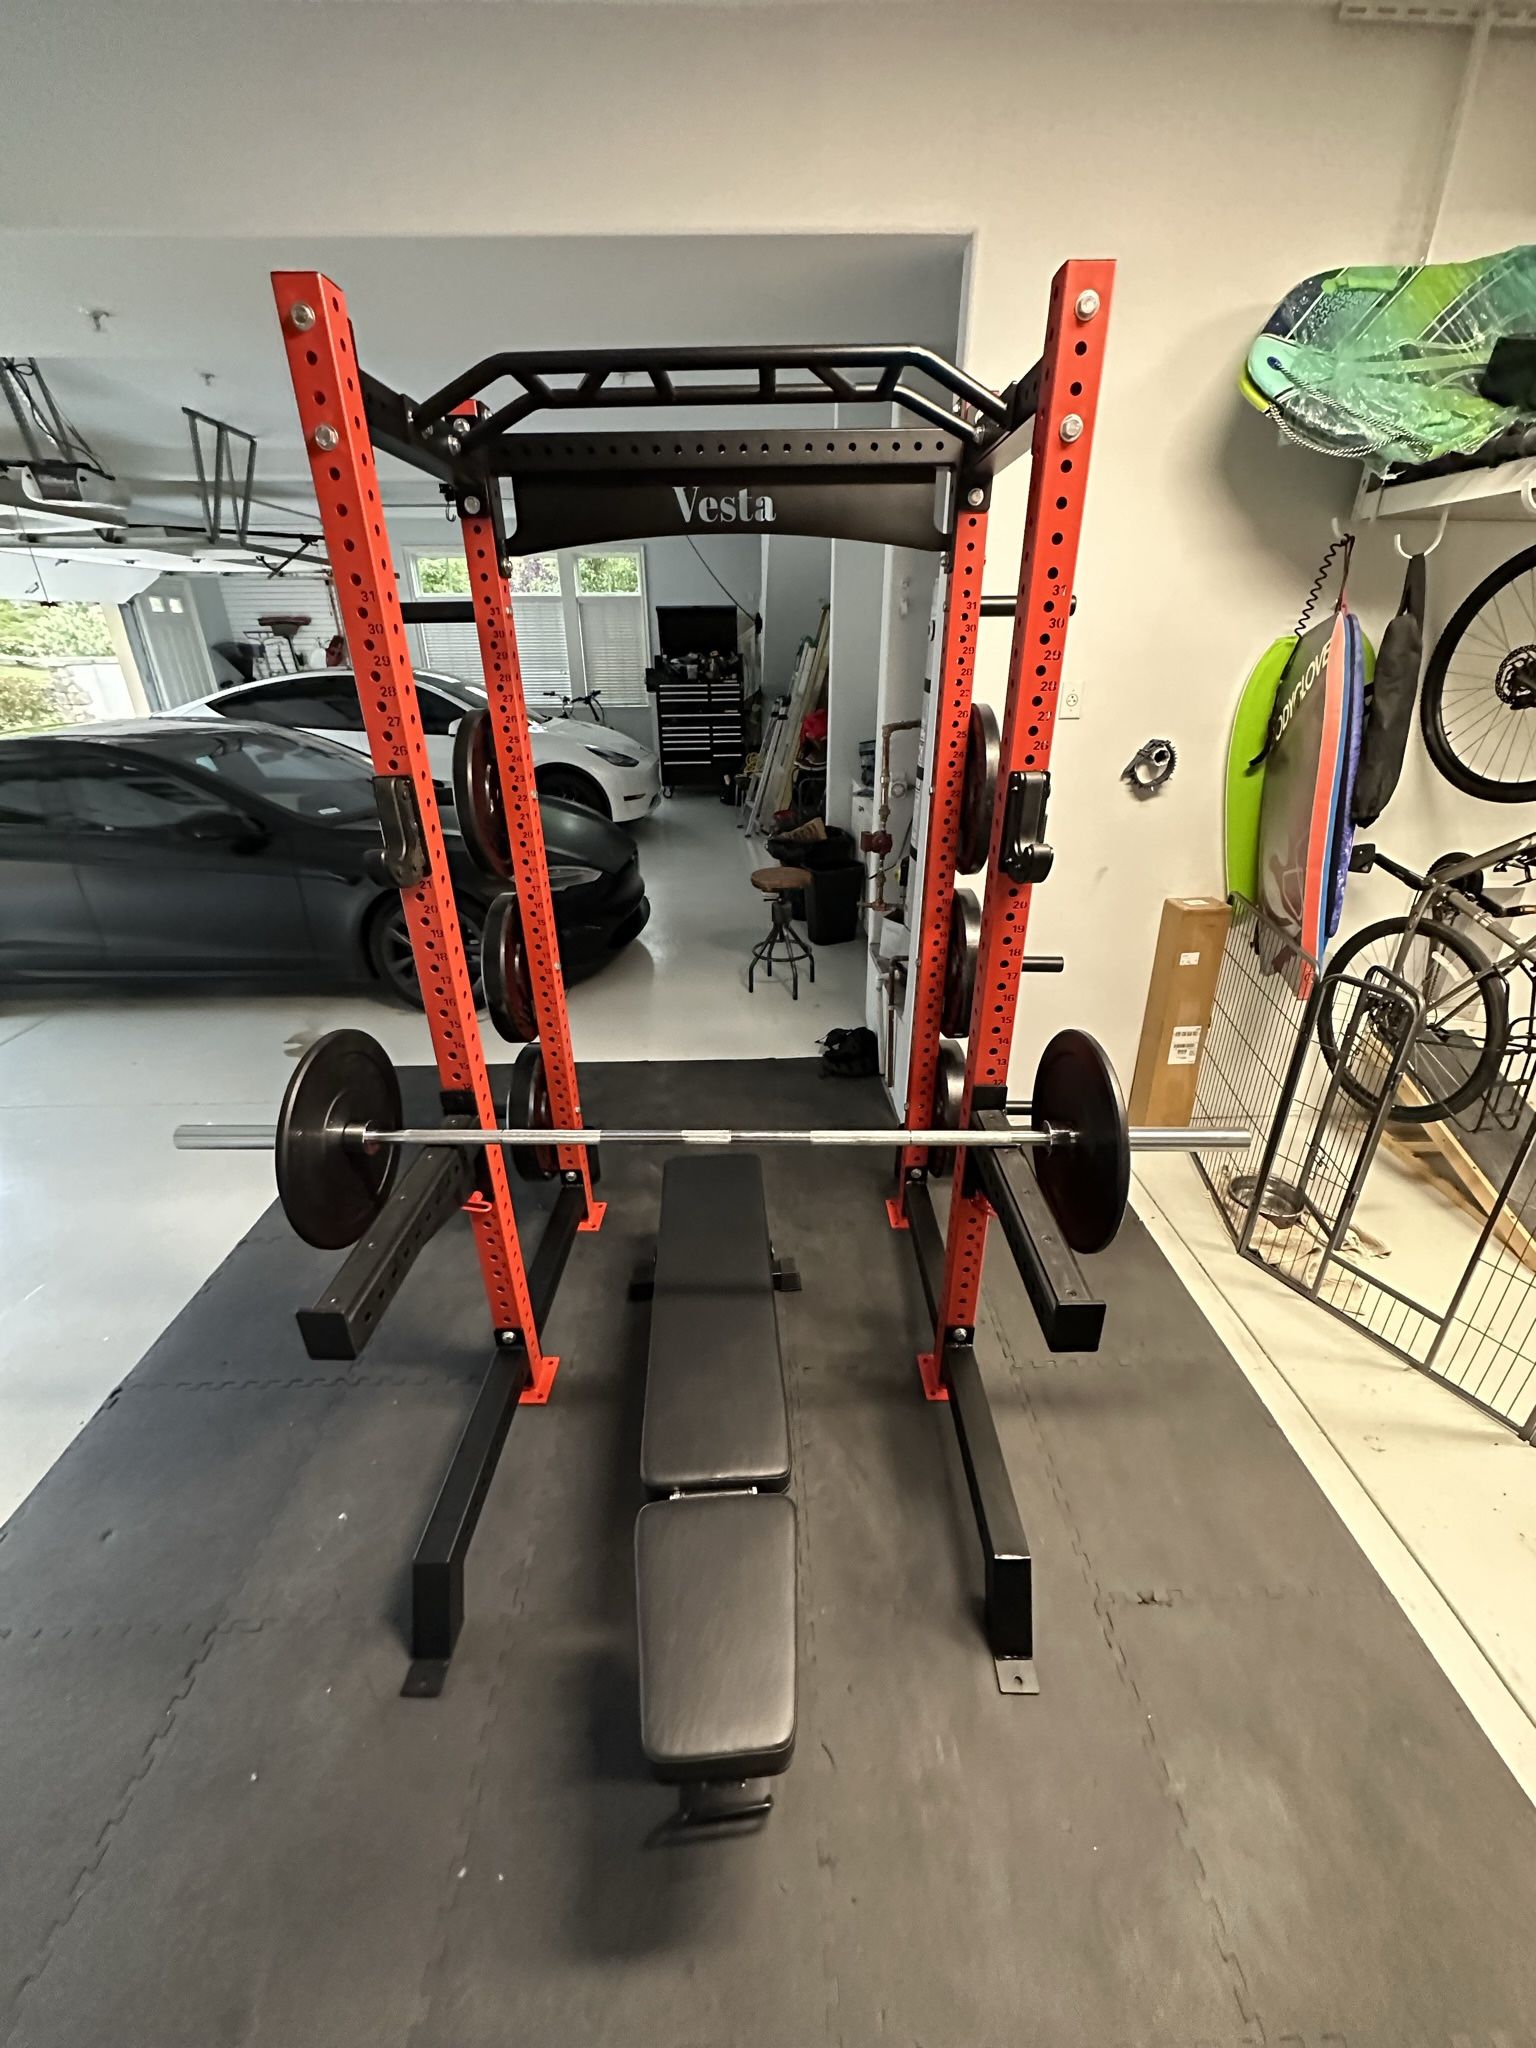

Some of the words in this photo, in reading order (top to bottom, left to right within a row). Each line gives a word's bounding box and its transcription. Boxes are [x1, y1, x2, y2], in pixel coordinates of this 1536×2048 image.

[672, 486, 776, 523] Vesta
[361, 591, 376, 602] 31
[967, 602, 977, 610] 31
[490, 607, 500, 616] 31
[1049, 618, 1065, 628] 30
[368, 624, 384, 635] 30
[965, 624, 976, 632] 30
[1044, 650, 1061, 660] 29
[374, 656, 391, 666] 29
[381, 687, 397, 697] 28
[387, 717, 401, 727] 27
[509, 736, 520, 744] 25
[1033, 741, 1049, 750] 26
[392, 746, 408, 756] 26
[419, 881, 432, 889] 21
[424, 905, 438, 914] 20
[1013, 925, 1025, 933] 19
[1007, 972, 1018, 980] 17
[1003, 994, 1015, 1002] 16
